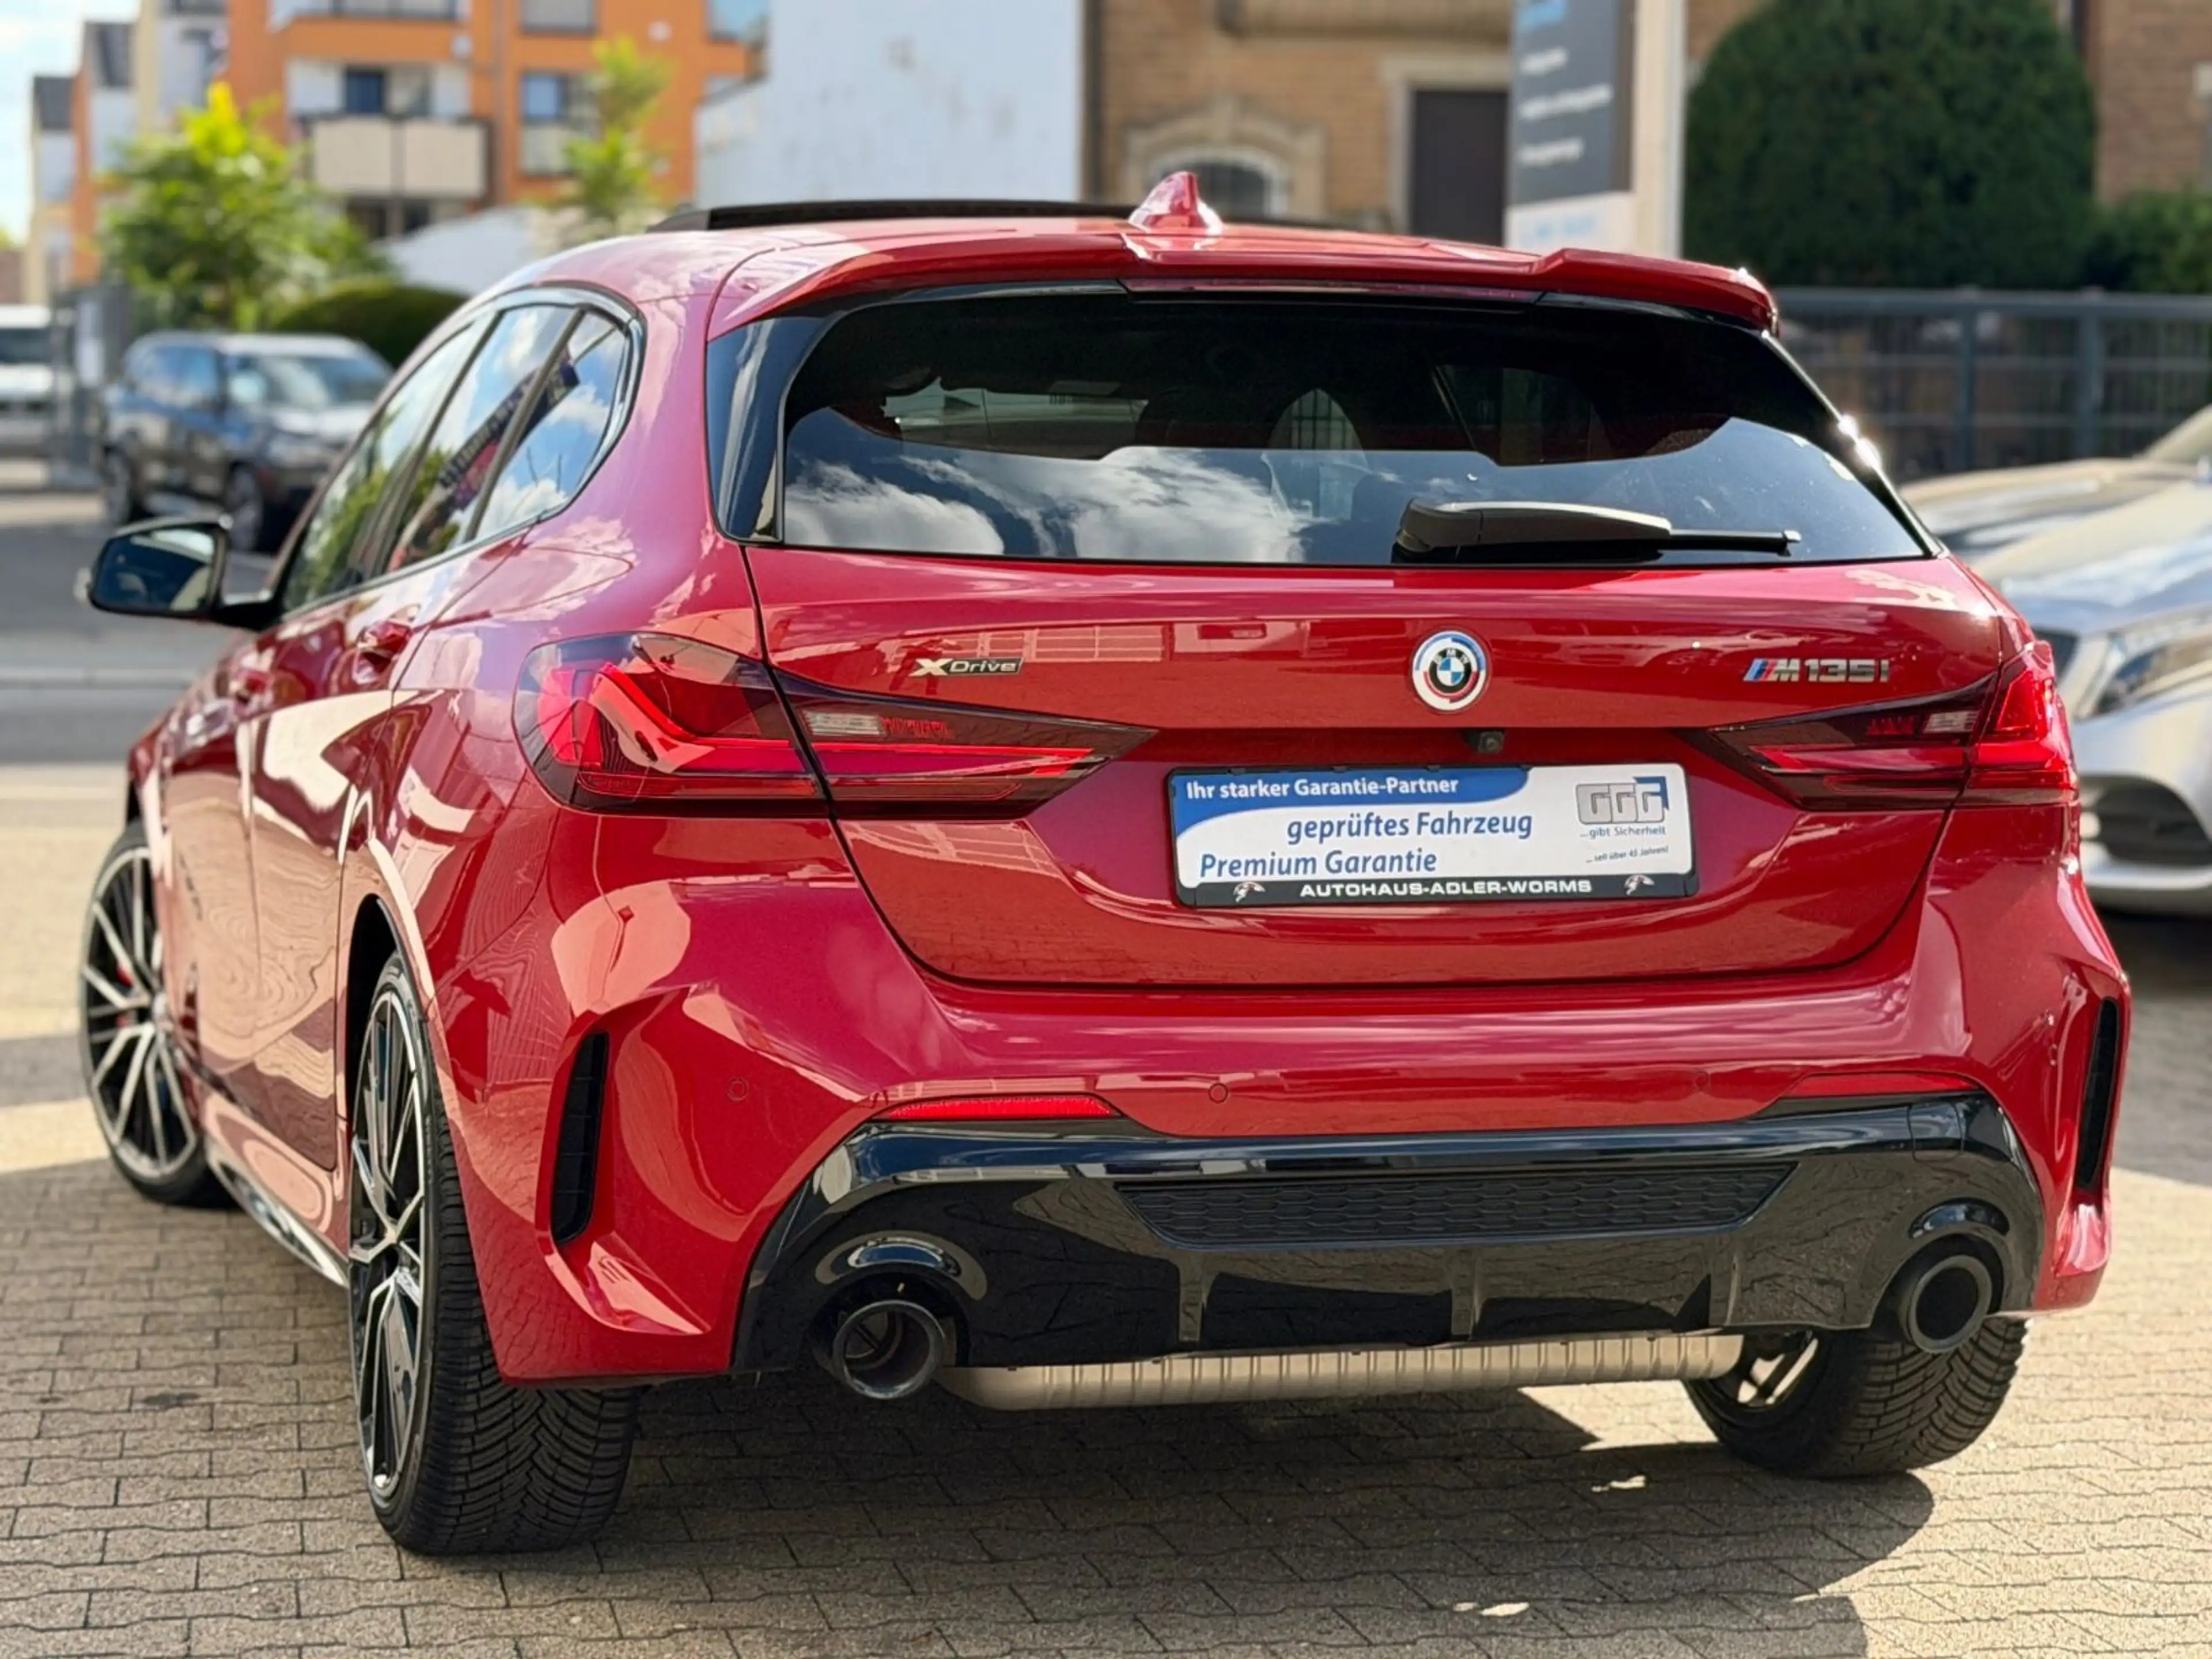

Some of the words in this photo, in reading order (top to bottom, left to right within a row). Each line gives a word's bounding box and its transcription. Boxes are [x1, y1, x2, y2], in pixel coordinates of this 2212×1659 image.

[1187, 783, 1214, 799] Ihr
[1219, 781, 1289, 797] starker
[1294, 778, 1459, 796] Garantie-Partner
[1287, 812, 1409, 845] geprüftes
[1416, 809, 1532, 839] Fahrzeug
[1200, 851, 1317, 877] Premium
[1325, 849, 1437, 874] Garantie
[1300, 880, 1592, 897] AUTOHAUS-ADLER-WORMS
